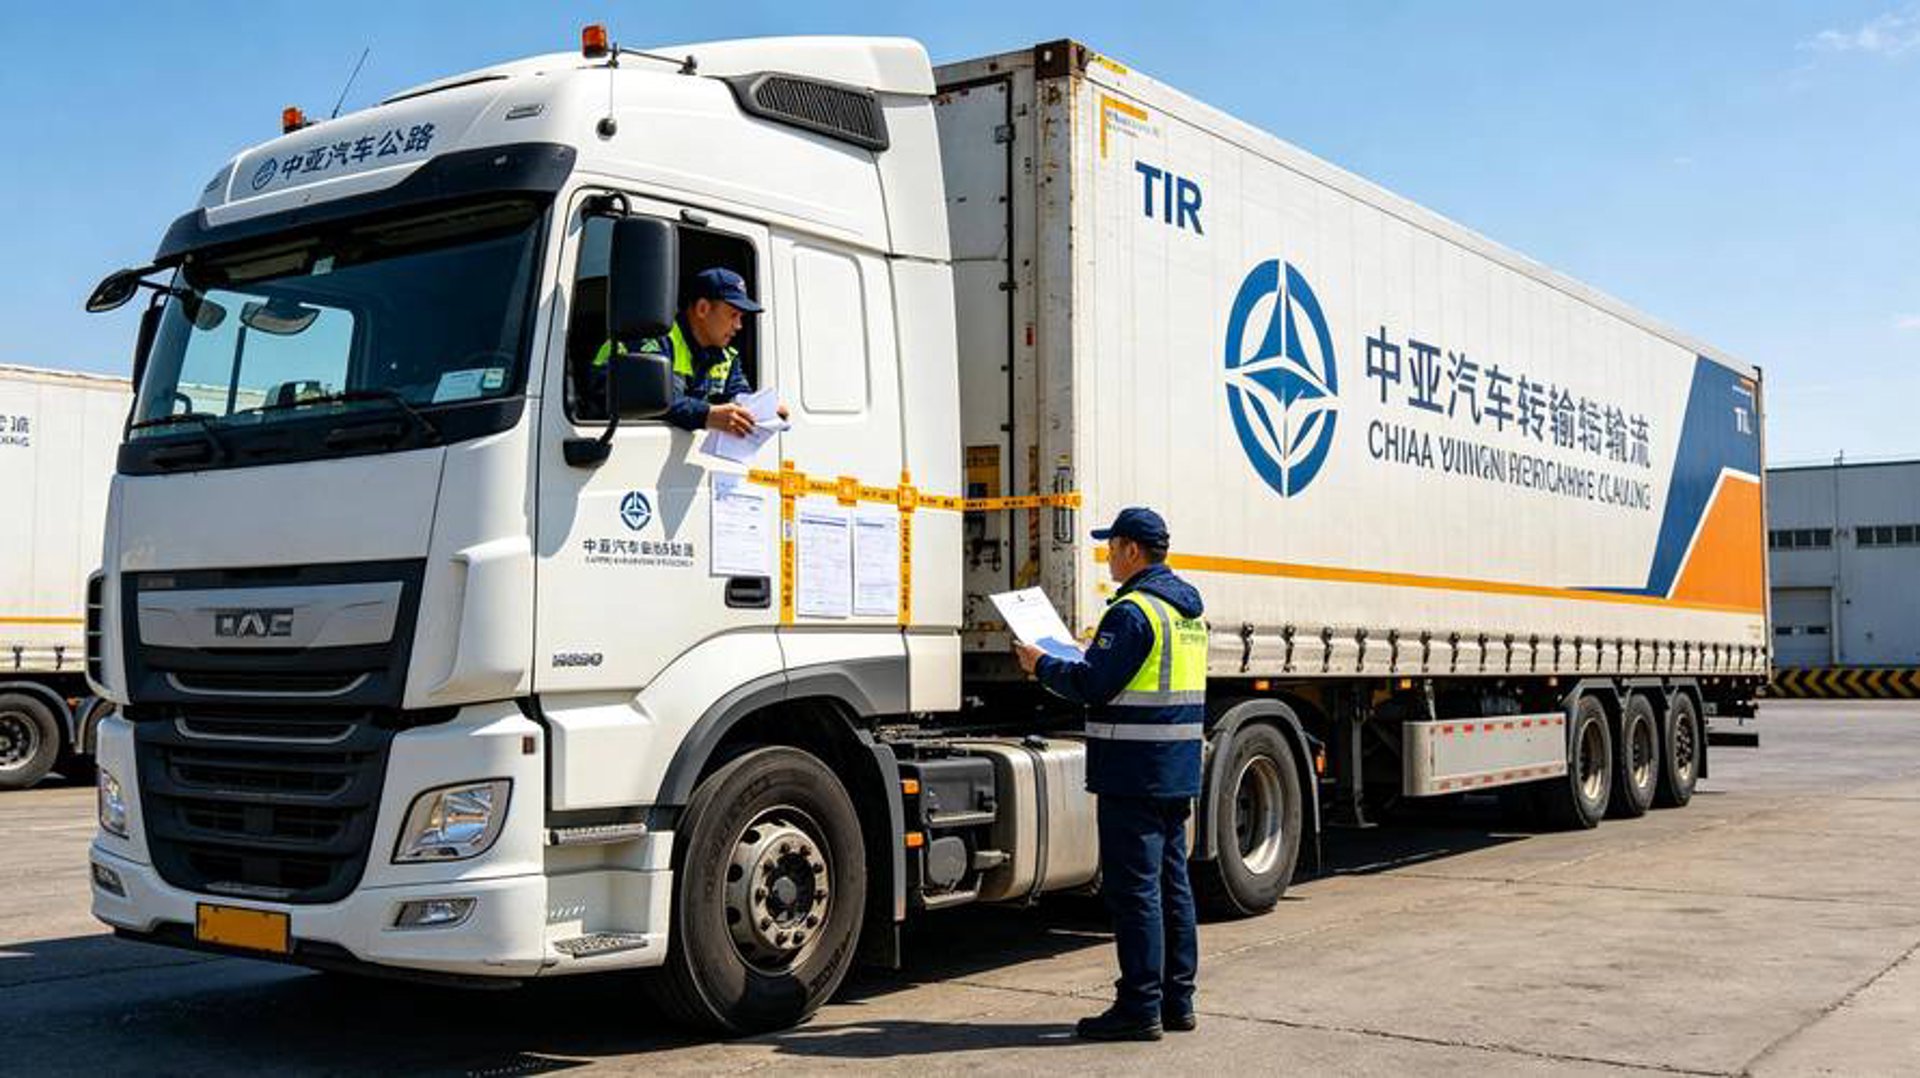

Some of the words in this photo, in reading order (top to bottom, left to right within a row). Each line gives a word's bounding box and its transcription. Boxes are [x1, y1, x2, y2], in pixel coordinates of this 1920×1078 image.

[281, 122, 435, 179] 中亚汽车公路
[1135, 160, 1204, 236] TIR
[1368, 420, 1434, 469] CHIAA
